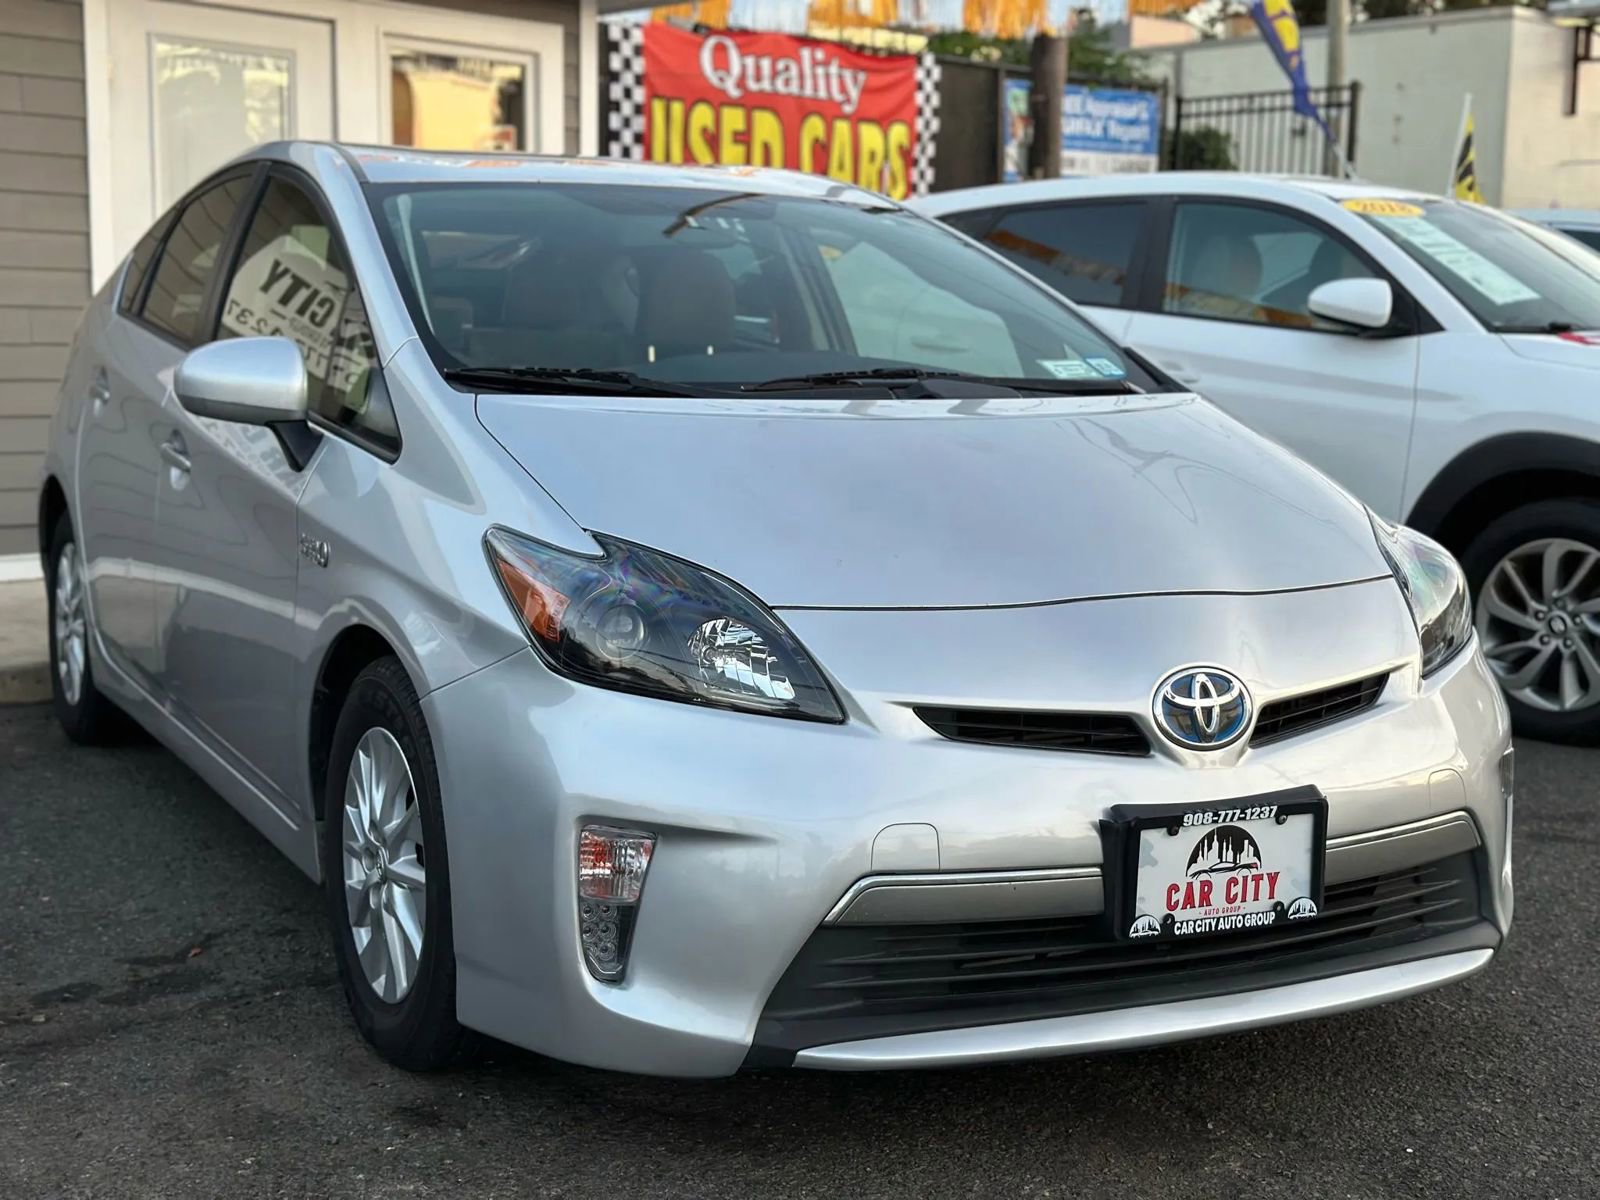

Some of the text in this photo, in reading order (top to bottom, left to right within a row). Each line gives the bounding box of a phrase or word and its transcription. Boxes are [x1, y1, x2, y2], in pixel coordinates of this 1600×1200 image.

[699, 35, 867, 114] Quality
[651, 98, 909, 200] USED CARS
[1183, 805, 1278, 827] 908-777-1237
[1166, 871, 1280, 912] CAR CITY
[1174, 911, 1276, 936] CAR CITY AUTO GROUP
[1203, 905, 1241, 916] AUTO GROUP
